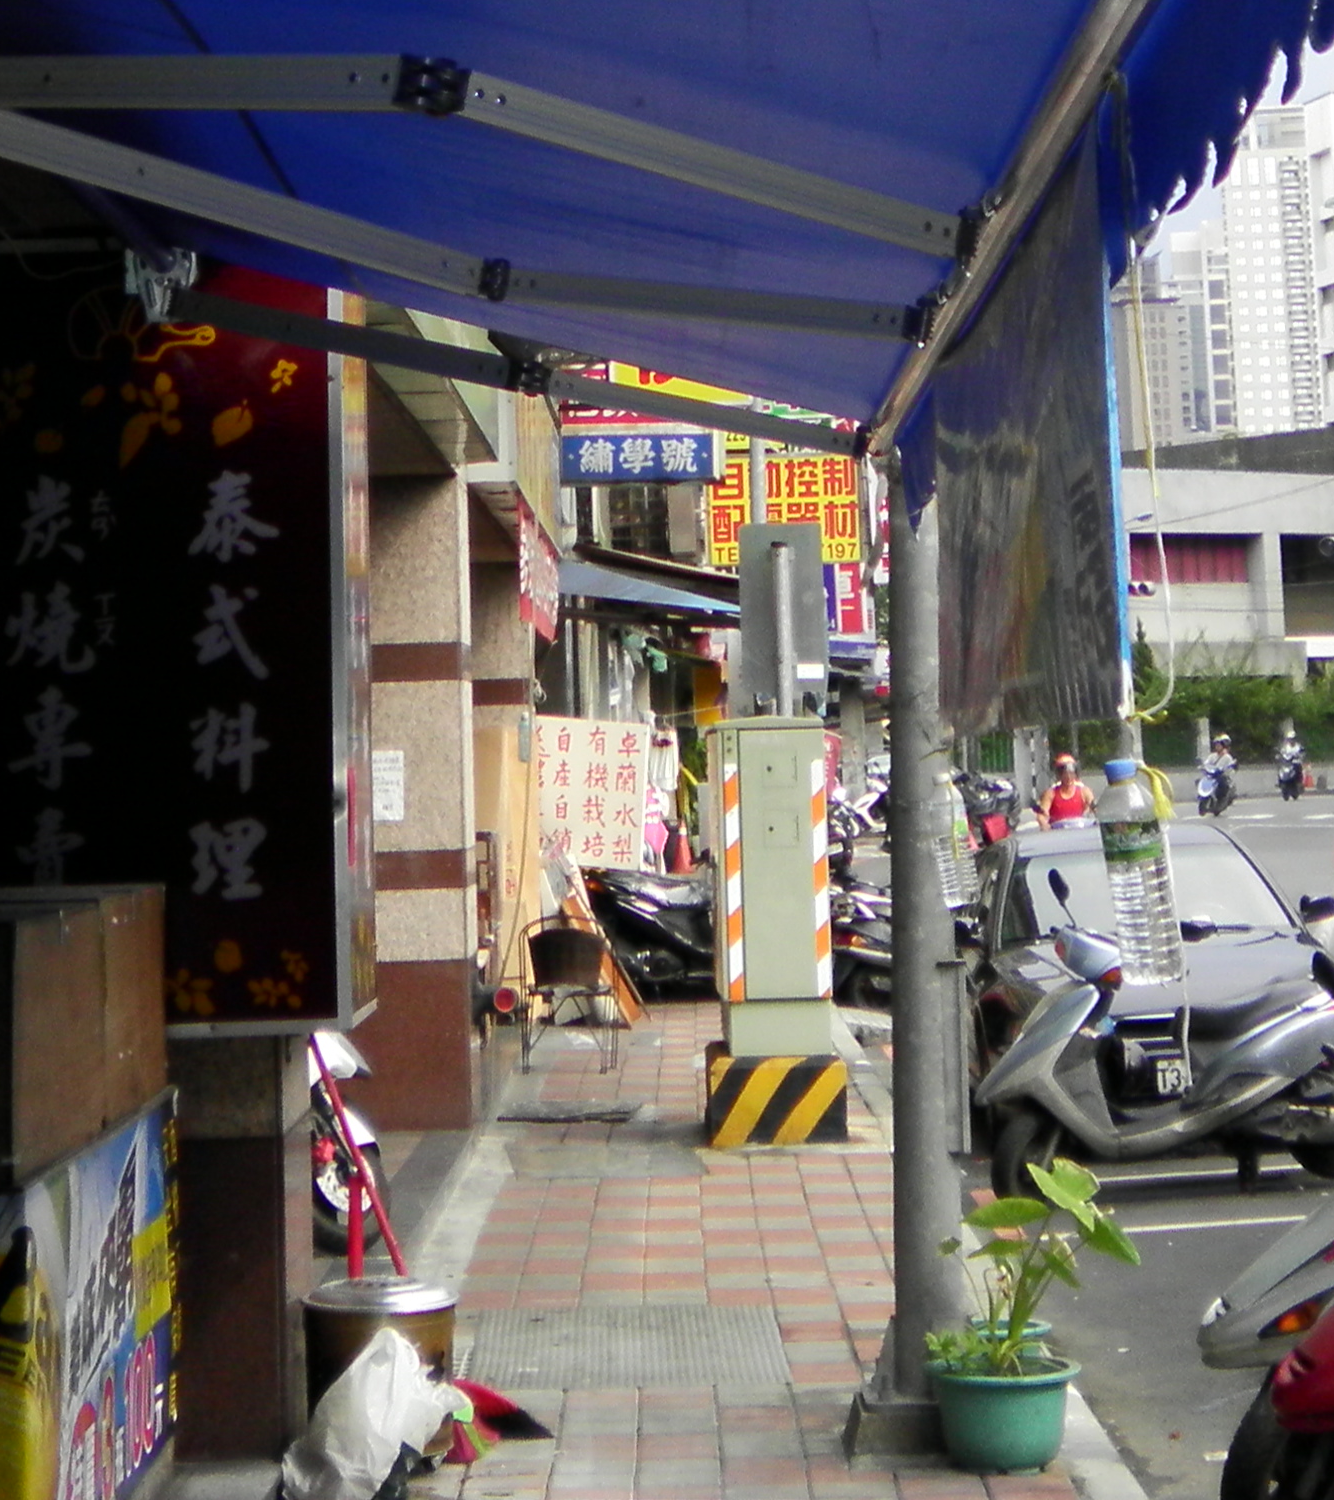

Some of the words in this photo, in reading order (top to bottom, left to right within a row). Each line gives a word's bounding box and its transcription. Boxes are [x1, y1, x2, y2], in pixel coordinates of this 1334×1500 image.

[579, 438, 699, 474] 繡學號
[188, 469, 279, 901] 泰式料理
[581, 725, 609, 858] 有機栽培
[612, 731, 640, 864] 卓蘭水梨
